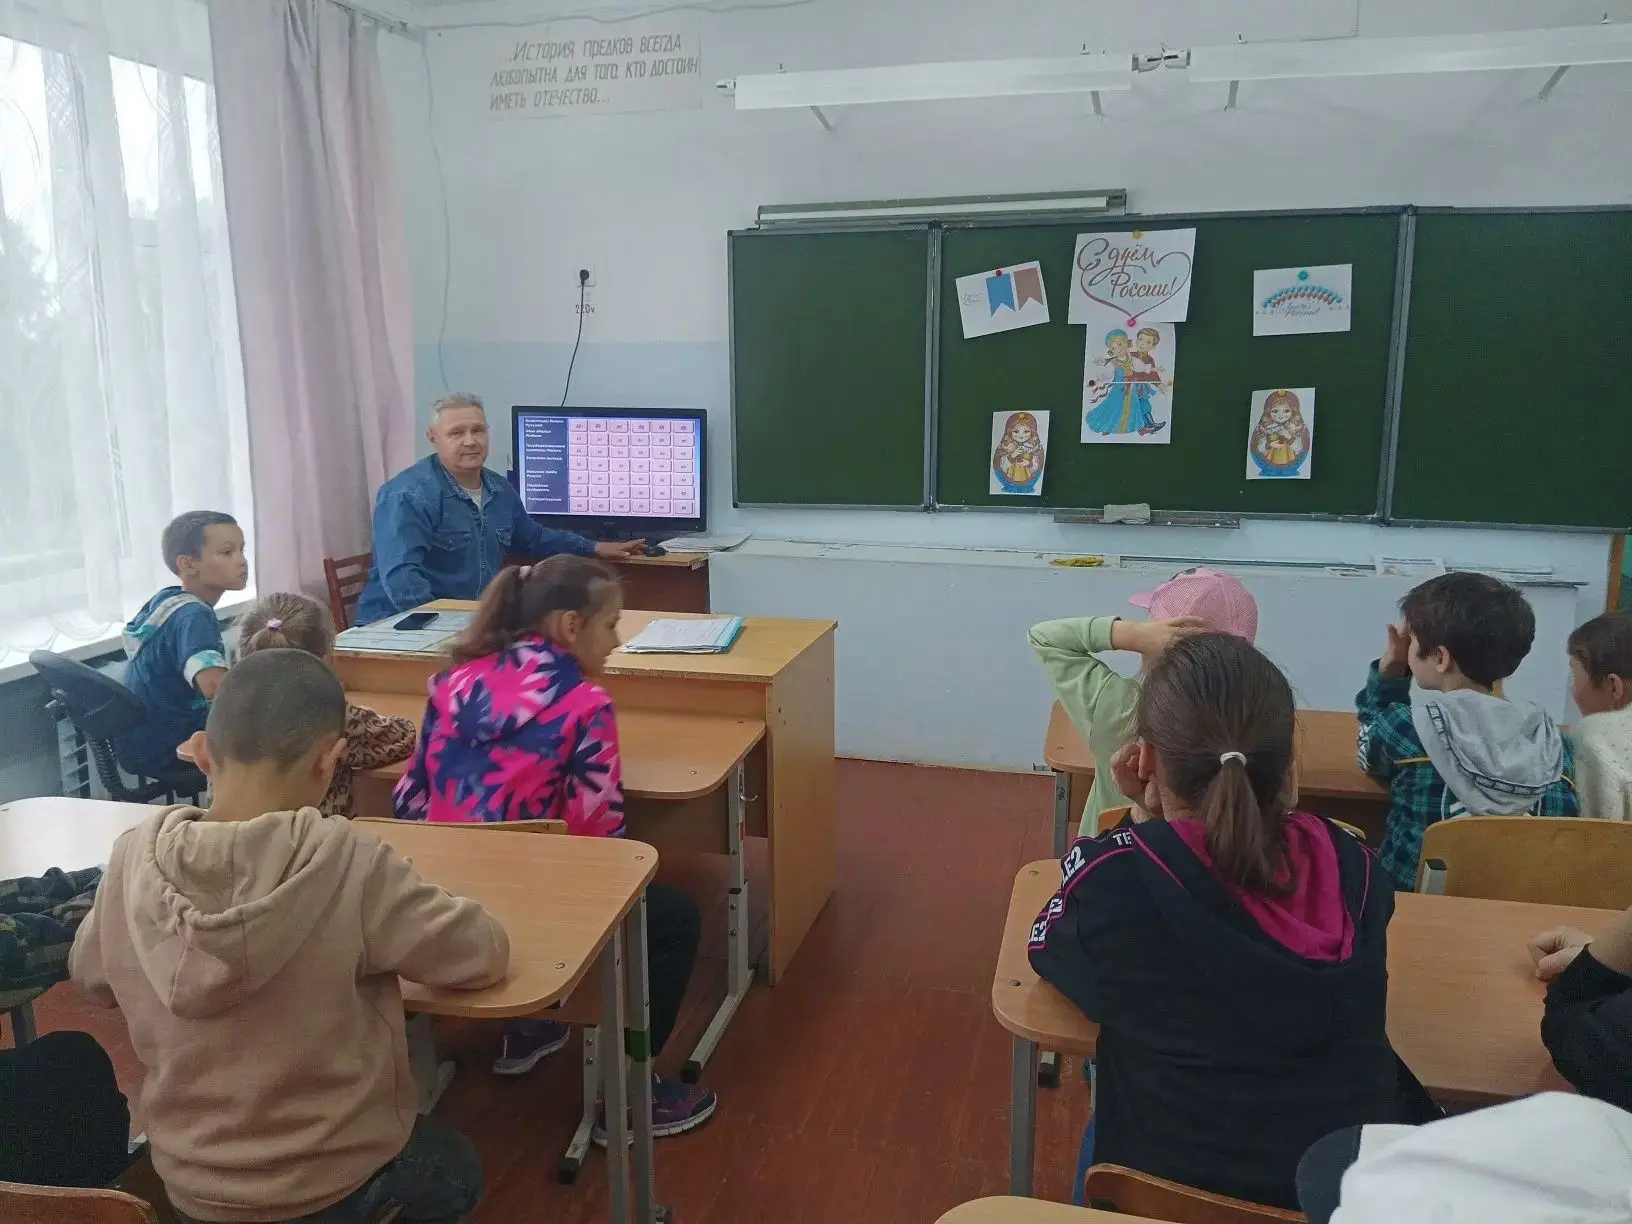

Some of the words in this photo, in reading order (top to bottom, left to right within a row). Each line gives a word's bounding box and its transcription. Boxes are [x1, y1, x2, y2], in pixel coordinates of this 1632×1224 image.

[640, 34, 681, 53] ВСЕГДА
[490, 67, 557, 86] ЛЮБОПЫТНА
[565, 64, 588, 82] ДЛЯ
[625, 61, 646, 78] КТО
[650, 57, 698, 78] ДОСТОИН
[490, 91, 526, 111] ИМЕТЬ
[1077, 238, 1109, 270] С
[1111, 272, 1178, 298] России!
